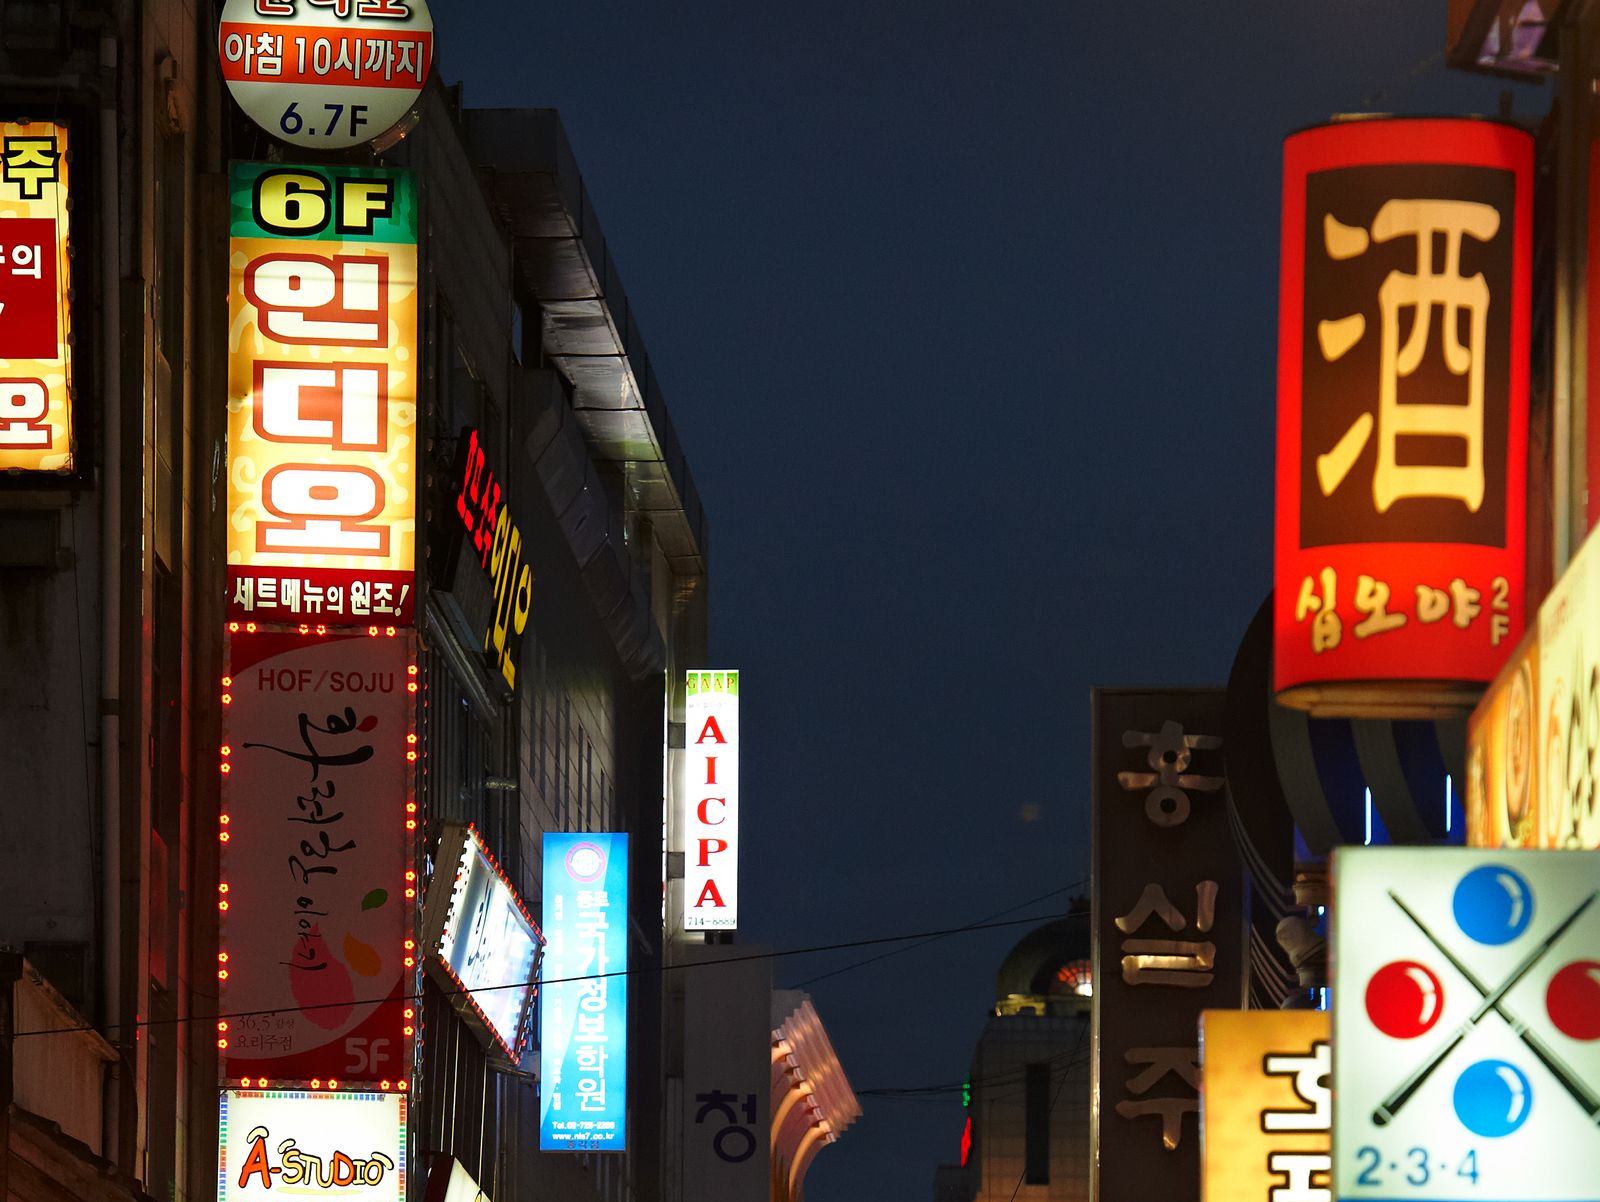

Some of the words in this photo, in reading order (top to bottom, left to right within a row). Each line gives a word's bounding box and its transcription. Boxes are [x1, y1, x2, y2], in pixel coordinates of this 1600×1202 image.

[225, 32, 284, 75] 아침
[295, 37, 424, 83] 10시까지
[280, 102, 369, 137] 6.7F
[251, 168, 395, 236] 6F
[1317, 198, 1501, 513] 酒
[244, 253, 390, 557] 인디오
[233, 577, 344, 614] 세트메뉴의
[349, 580, 409, 617] 원조!
[257, 668, 394, 693] HOF/SOJU
[693, 715, 729, 908] AICPA
[345, 1037, 391, 1074] 5F
